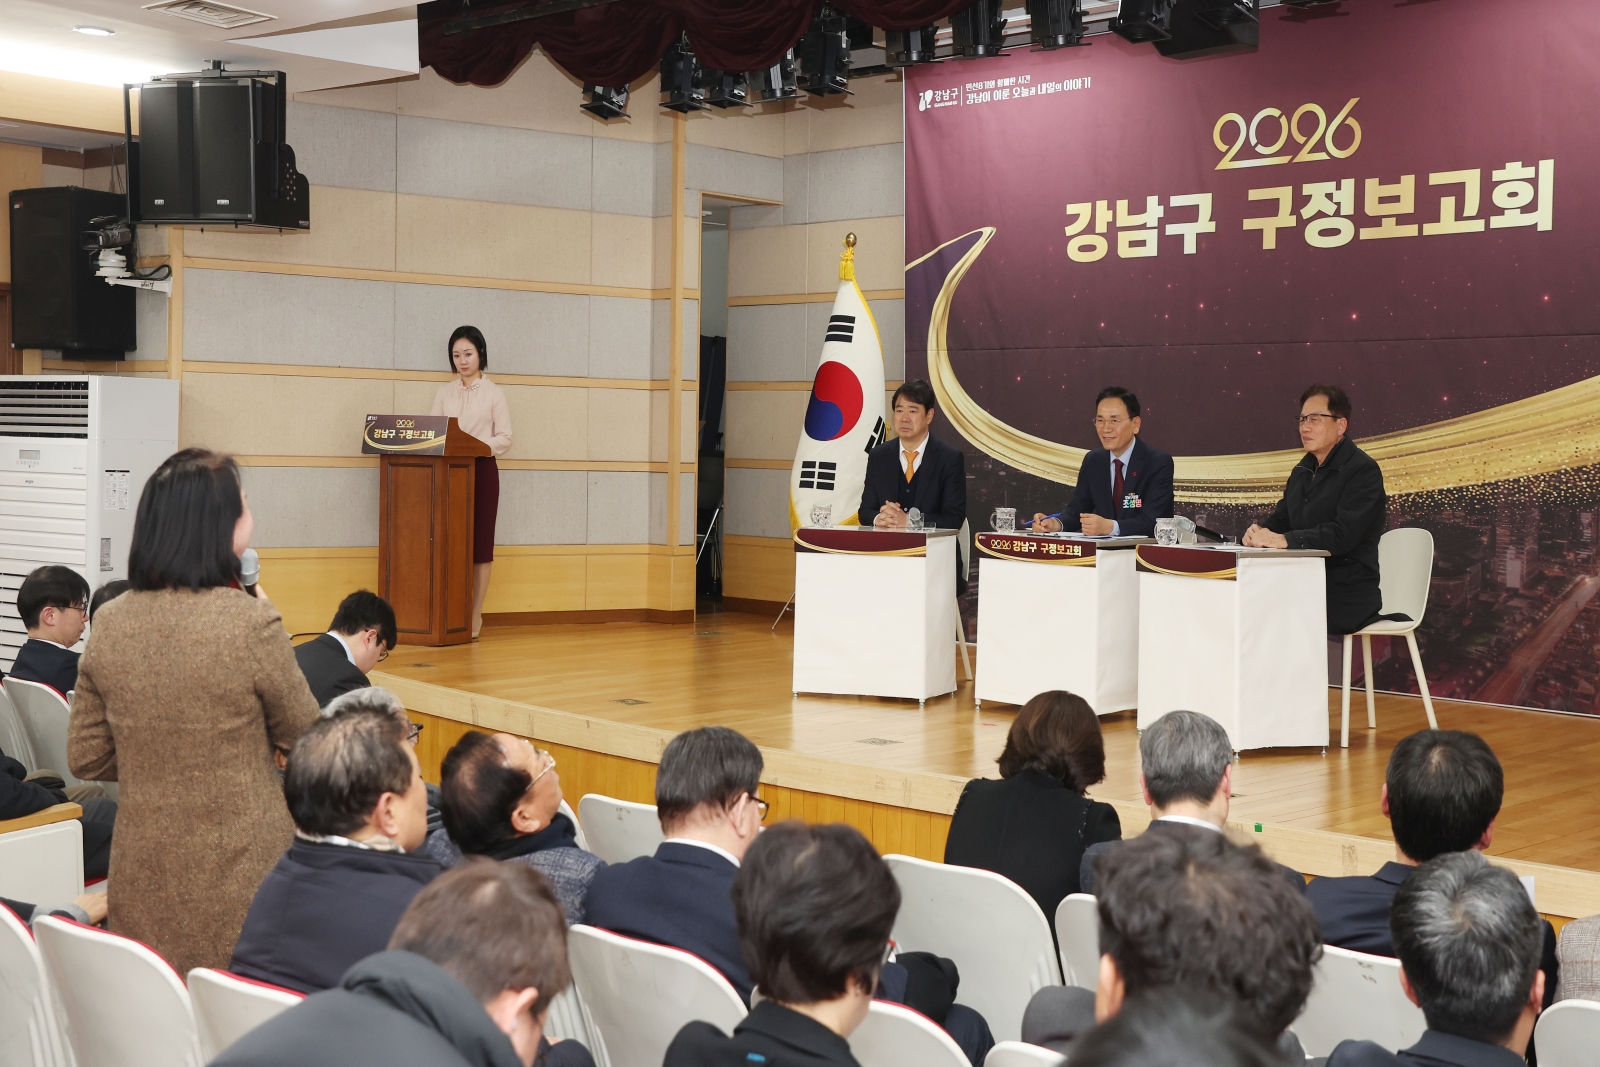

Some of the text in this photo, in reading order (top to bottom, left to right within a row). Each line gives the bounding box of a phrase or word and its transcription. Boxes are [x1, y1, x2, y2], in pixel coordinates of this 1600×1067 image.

[1017, 74, 1031, 85] 시간
[934, 88, 959, 102] 강남구
[966, 76, 1091, 104] 강남이 이룬 오늘과 내일의 이야기
[1213, 97, 1362, 170] 2026
[1064, 159, 1555, 263] 강남구 구정보고회
[396, 420, 415, 428] 2026
[373, 429, 435, 440] 강남구 구정보고회
[1122, 498, 1142, 509] 조성명
[990, 539, 1082, 557] 2026 강남구 구정보고회
